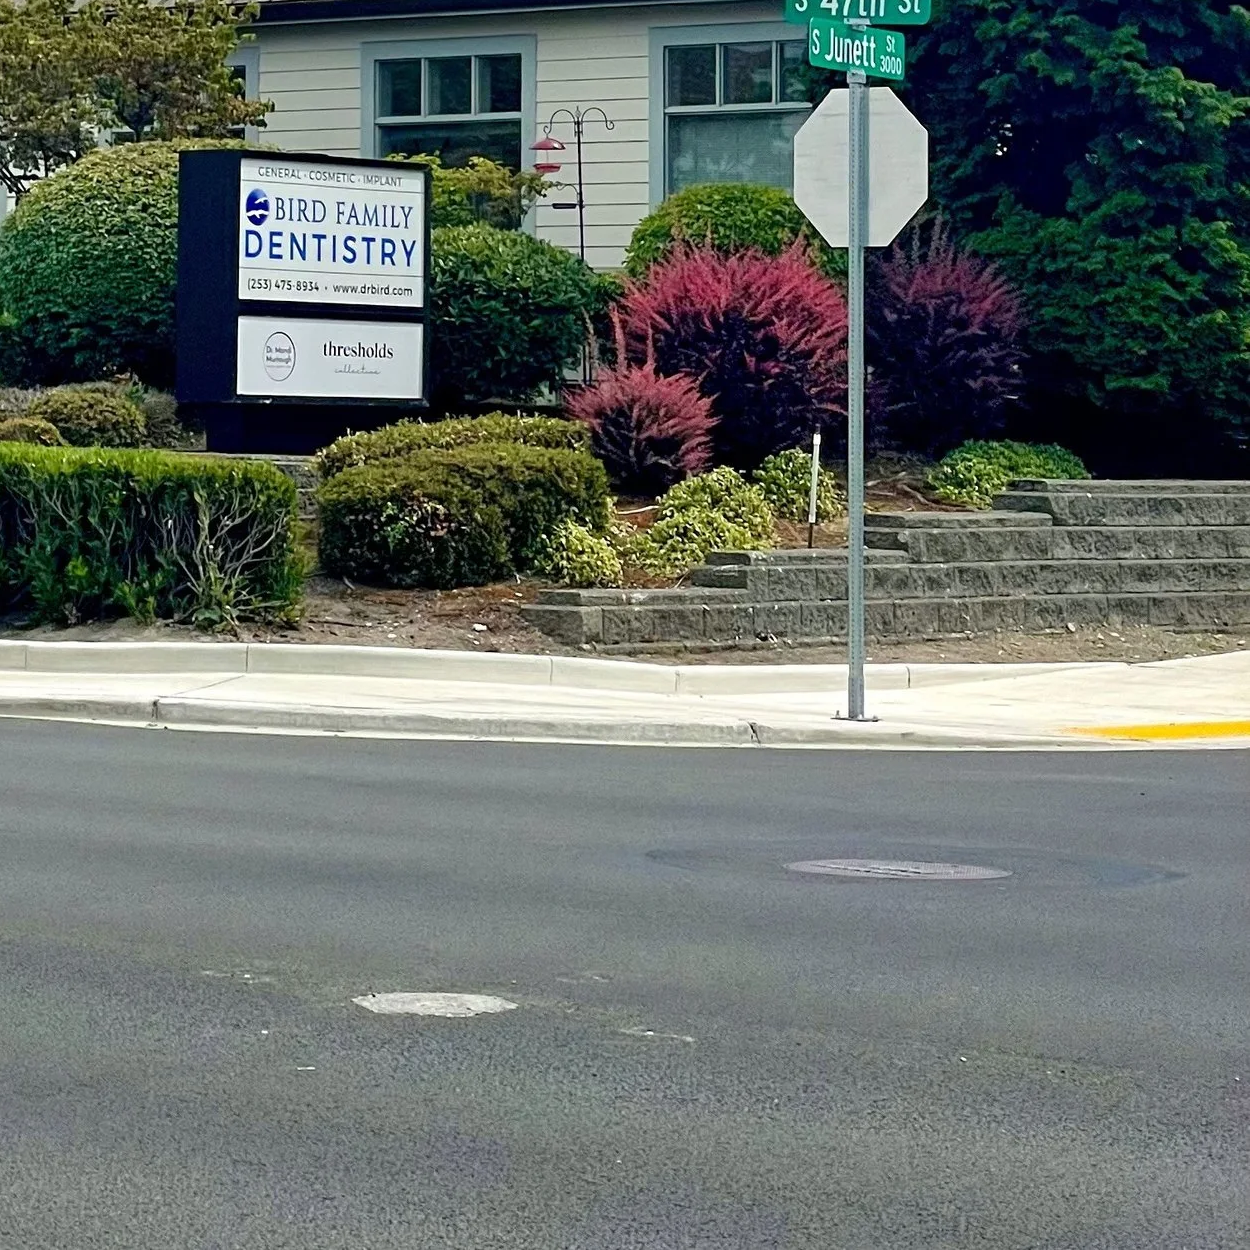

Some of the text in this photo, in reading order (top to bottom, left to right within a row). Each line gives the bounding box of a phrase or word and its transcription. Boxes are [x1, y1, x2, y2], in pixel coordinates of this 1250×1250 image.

[812, 27, 895, 68] S Junett St
[879, 56, 902, 75] 3000
[258, 166, 403, 188] GENERAL COSMETIC IMPLANT
[274, 197, 414, 230] BIRD FAMILY
[245, 229, 417, 268] DENTISTRY
[247, 278, 272, 291] (253)
[333, 284, 413, 297] www.drbird.com
[323, 341, 394, 359] thresholds
